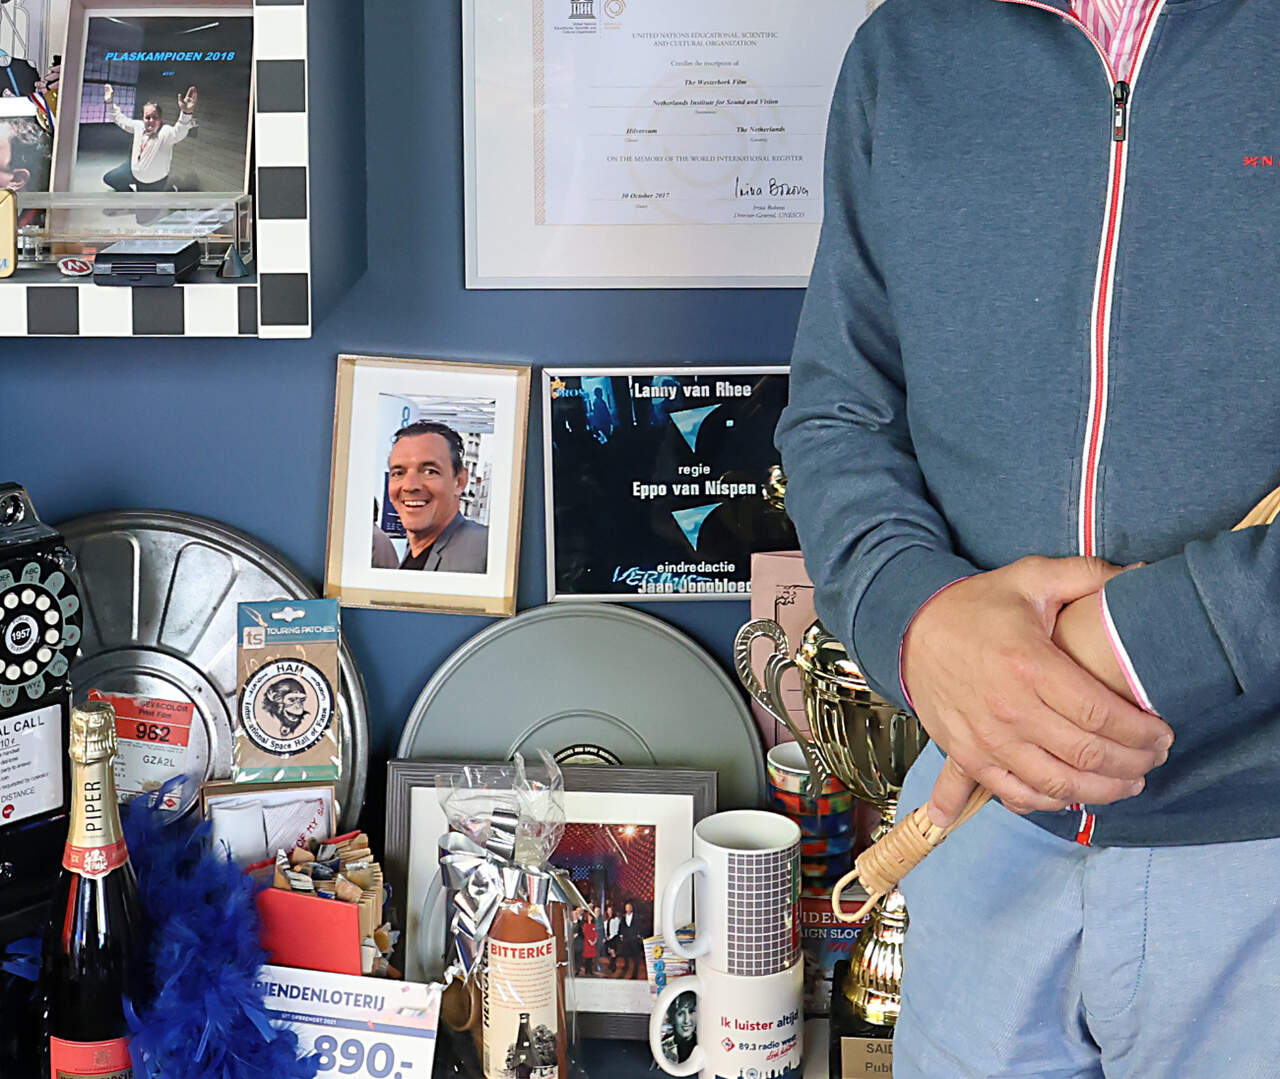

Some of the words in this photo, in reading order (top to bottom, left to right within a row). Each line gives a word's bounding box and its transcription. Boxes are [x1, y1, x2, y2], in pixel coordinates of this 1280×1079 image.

[104, 51, 204, 61] PLASKAMPIOEN
[204, 51, 236, 61] 2018
[634, 383, 677, 399] Lanny
[683, 384, 710, 397] van
[716, 381, 752, 397] Rhee
[678, 463, 711, 477] regie
[633, 481, 667, 499] Eppo
[673, 483, 699, 496] van
[705, 480, 756, 498] Nispen
[656, 561, 736, 573] eindredactie
[11, 628, 31, 641] 1957
[267, 626, 301, 635] TOURING
[302, 625, 336, 634] PATCHES
[246, 631, 264, 646] ts
[276, 664, 305, 675] HAM
[13, 716, 46, 735] CALL
[136, 722, 171, 743] 962
[245, 701, 270, 745] Interational
[270, 738, 292, 750] Space
[294, 735, 310, 748] Hall
[0, 738, 10, 749] 10
[0, 786, 36, 803] DISTANCE
[84, 780, 103, 832] PIPER
[490, 942, 553, 960] BITTERKE
[721, 1016, 732, 1028] Ik
[734, 1018, 774, 1032] luister
[776, 1009, 800, 1029] altijd
[738, 1041, 757, 1052] 89.3
[758, 1040, 780, 1051] radio
